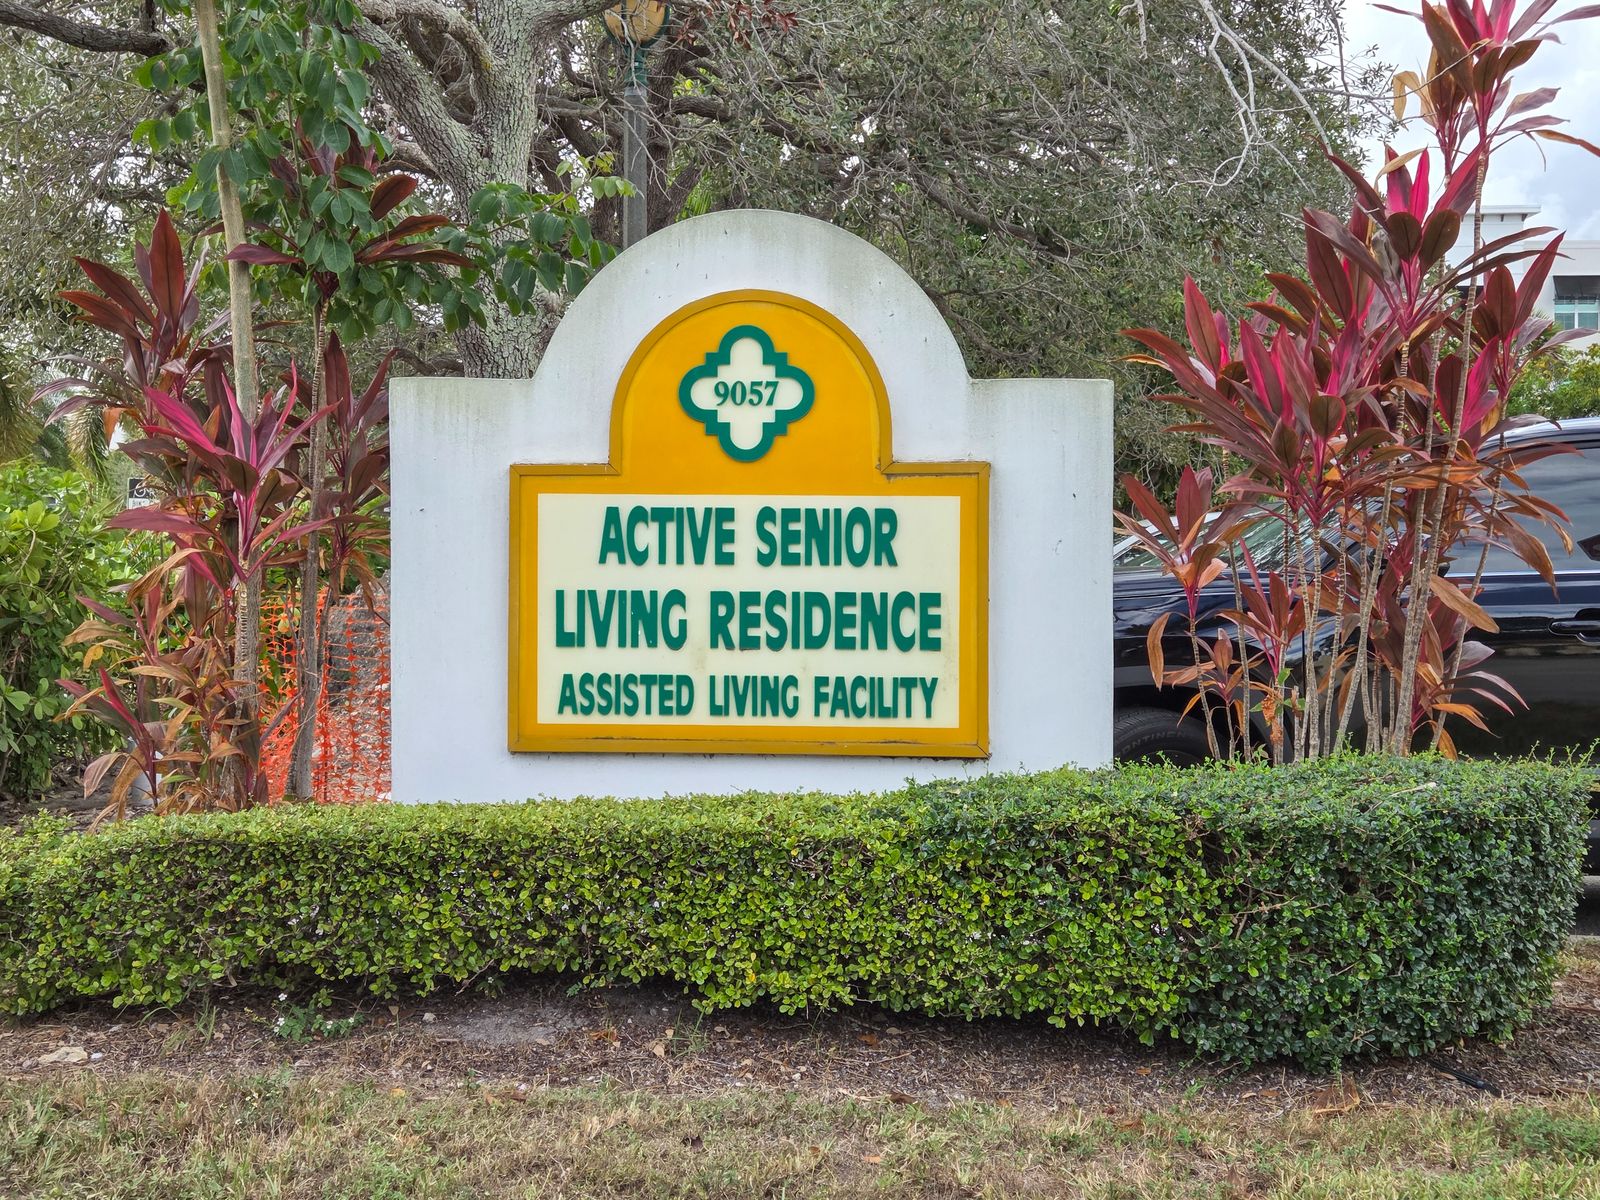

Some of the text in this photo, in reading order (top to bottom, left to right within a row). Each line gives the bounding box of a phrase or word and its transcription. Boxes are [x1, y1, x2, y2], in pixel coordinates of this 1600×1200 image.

[714, 381, 779, 406] 9057
[599, 506, 898, 567] ACTIVE SENIOR
[555, 589, 942, 651] LIVING RESIDENCE
[558, 673, 938, 718] ASSISTED LIVING FACILITY
